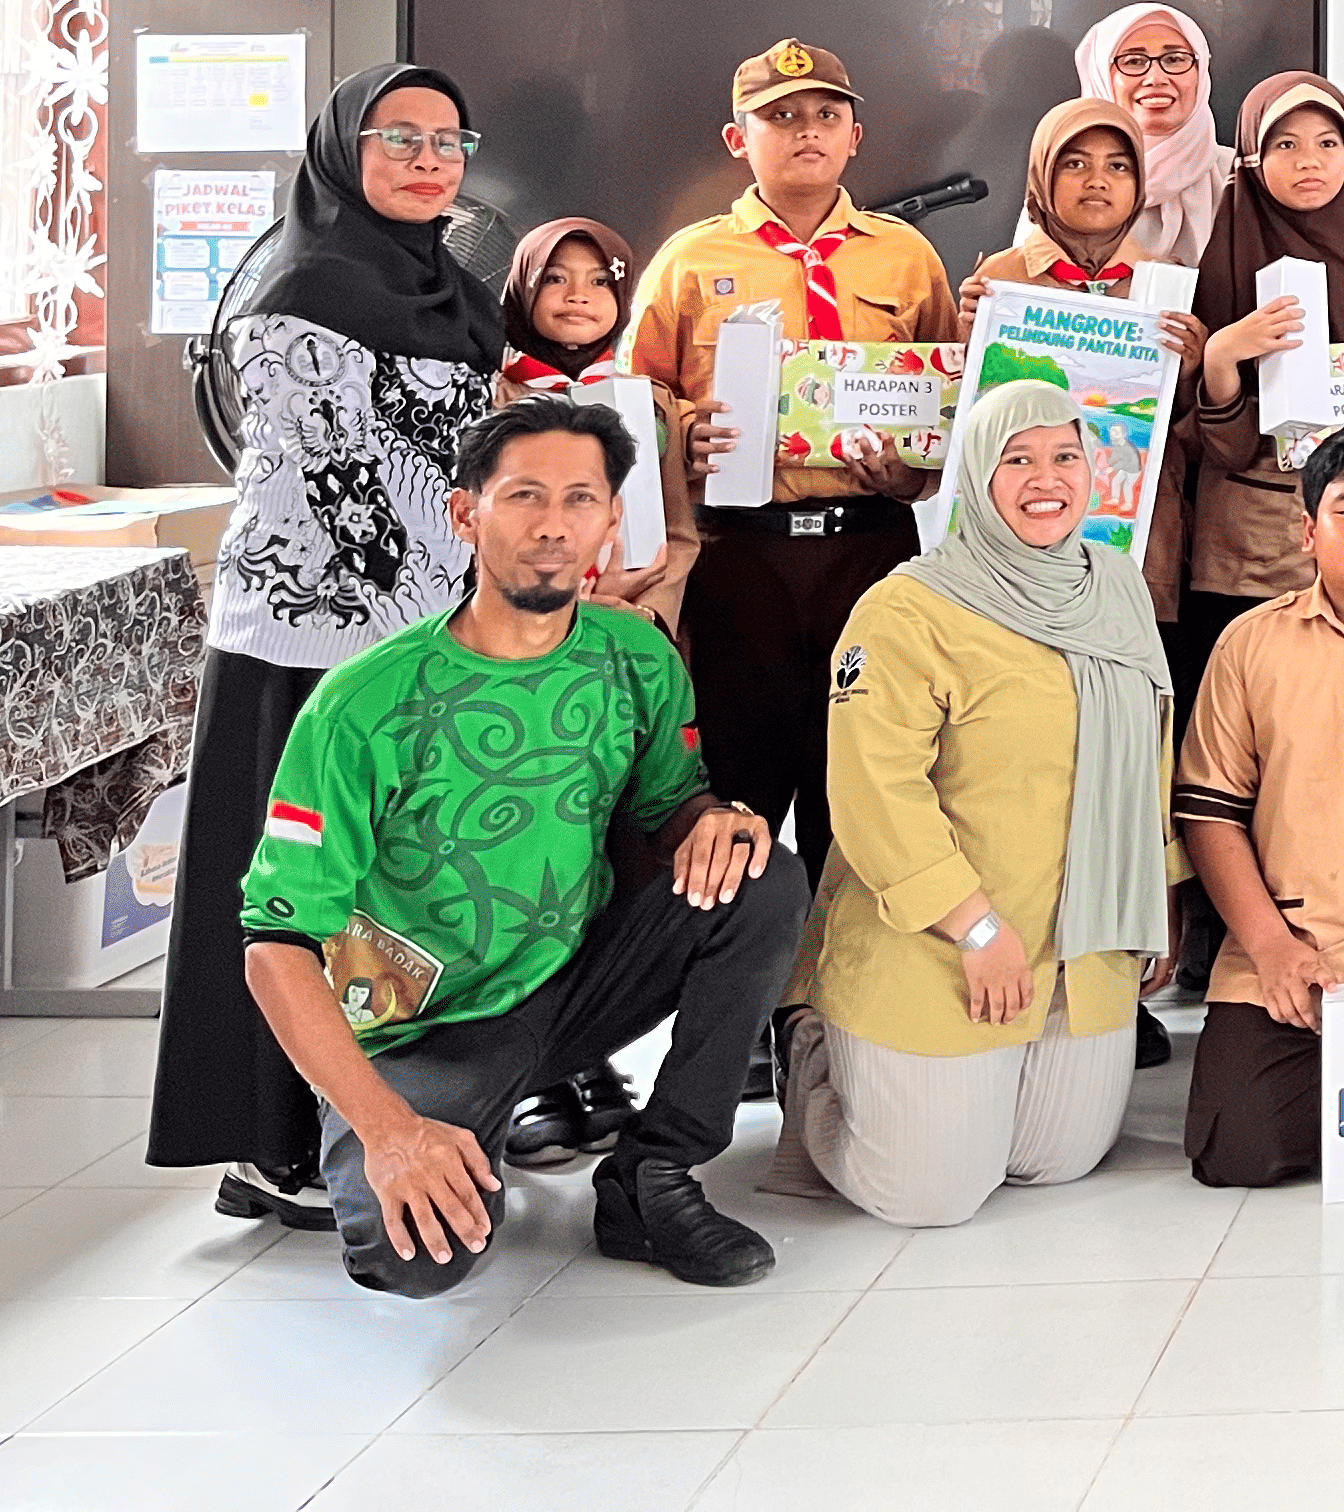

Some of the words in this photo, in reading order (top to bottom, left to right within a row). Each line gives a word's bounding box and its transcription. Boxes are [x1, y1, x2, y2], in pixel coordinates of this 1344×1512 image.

[182, 184, 249, 196] JADWAL
[1023, 306, 1144, 342] MANGROVE:
[998, 324, 1075, 349] PELINDUNG
[1076, 336, 1127, 357] PANTAI
[1128, 345, 1159, 363] KITA
[844, 379, 919, 393] HARAPAN
[924, 381, 932, 394] 3
[859, 403, 918, 417] POSTER
[376, 938, 427, 979] BADAK
